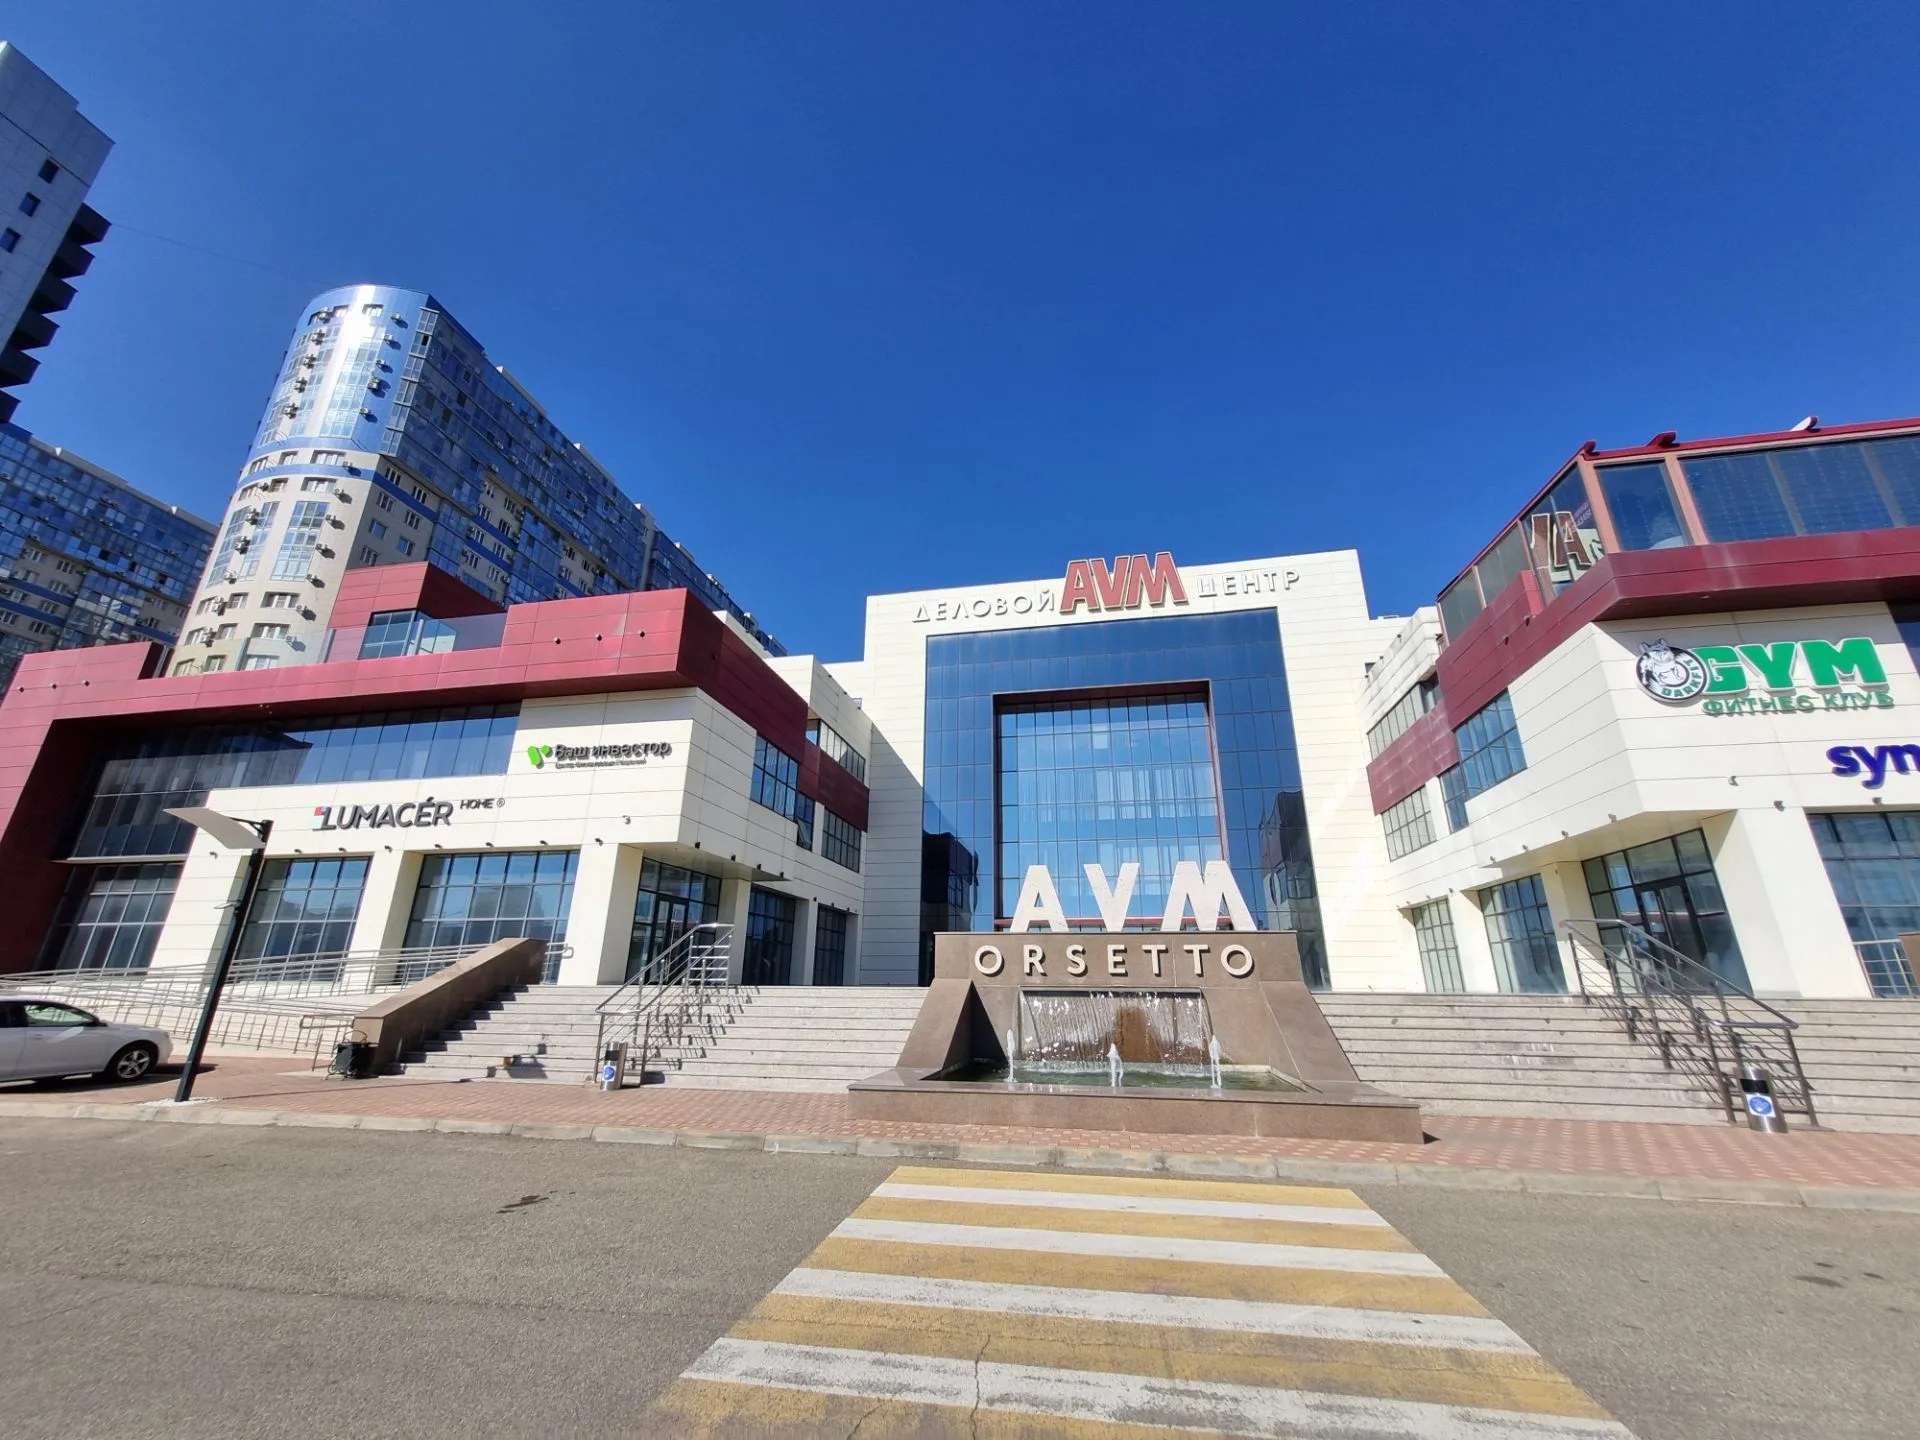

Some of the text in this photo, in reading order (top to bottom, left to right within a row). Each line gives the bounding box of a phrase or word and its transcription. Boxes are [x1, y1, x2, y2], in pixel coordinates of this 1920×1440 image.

[912, 551, 1300, 623] ДЕЛОВОЙ AVM ЦЕНТР
[1688, 636, 1889, 695] GYM
[1701, 689, 1896, 717] ФИТНЕС КЛУБ
[554, 741, 672, 762] Ваш инвестор
[312, 796, 454, 831] LUMACÉR
[459, 797, 495, 810] HOME
[1009, 860, 1258, 932] AVM
[973, 943, 1254, 977] ORSETTO
